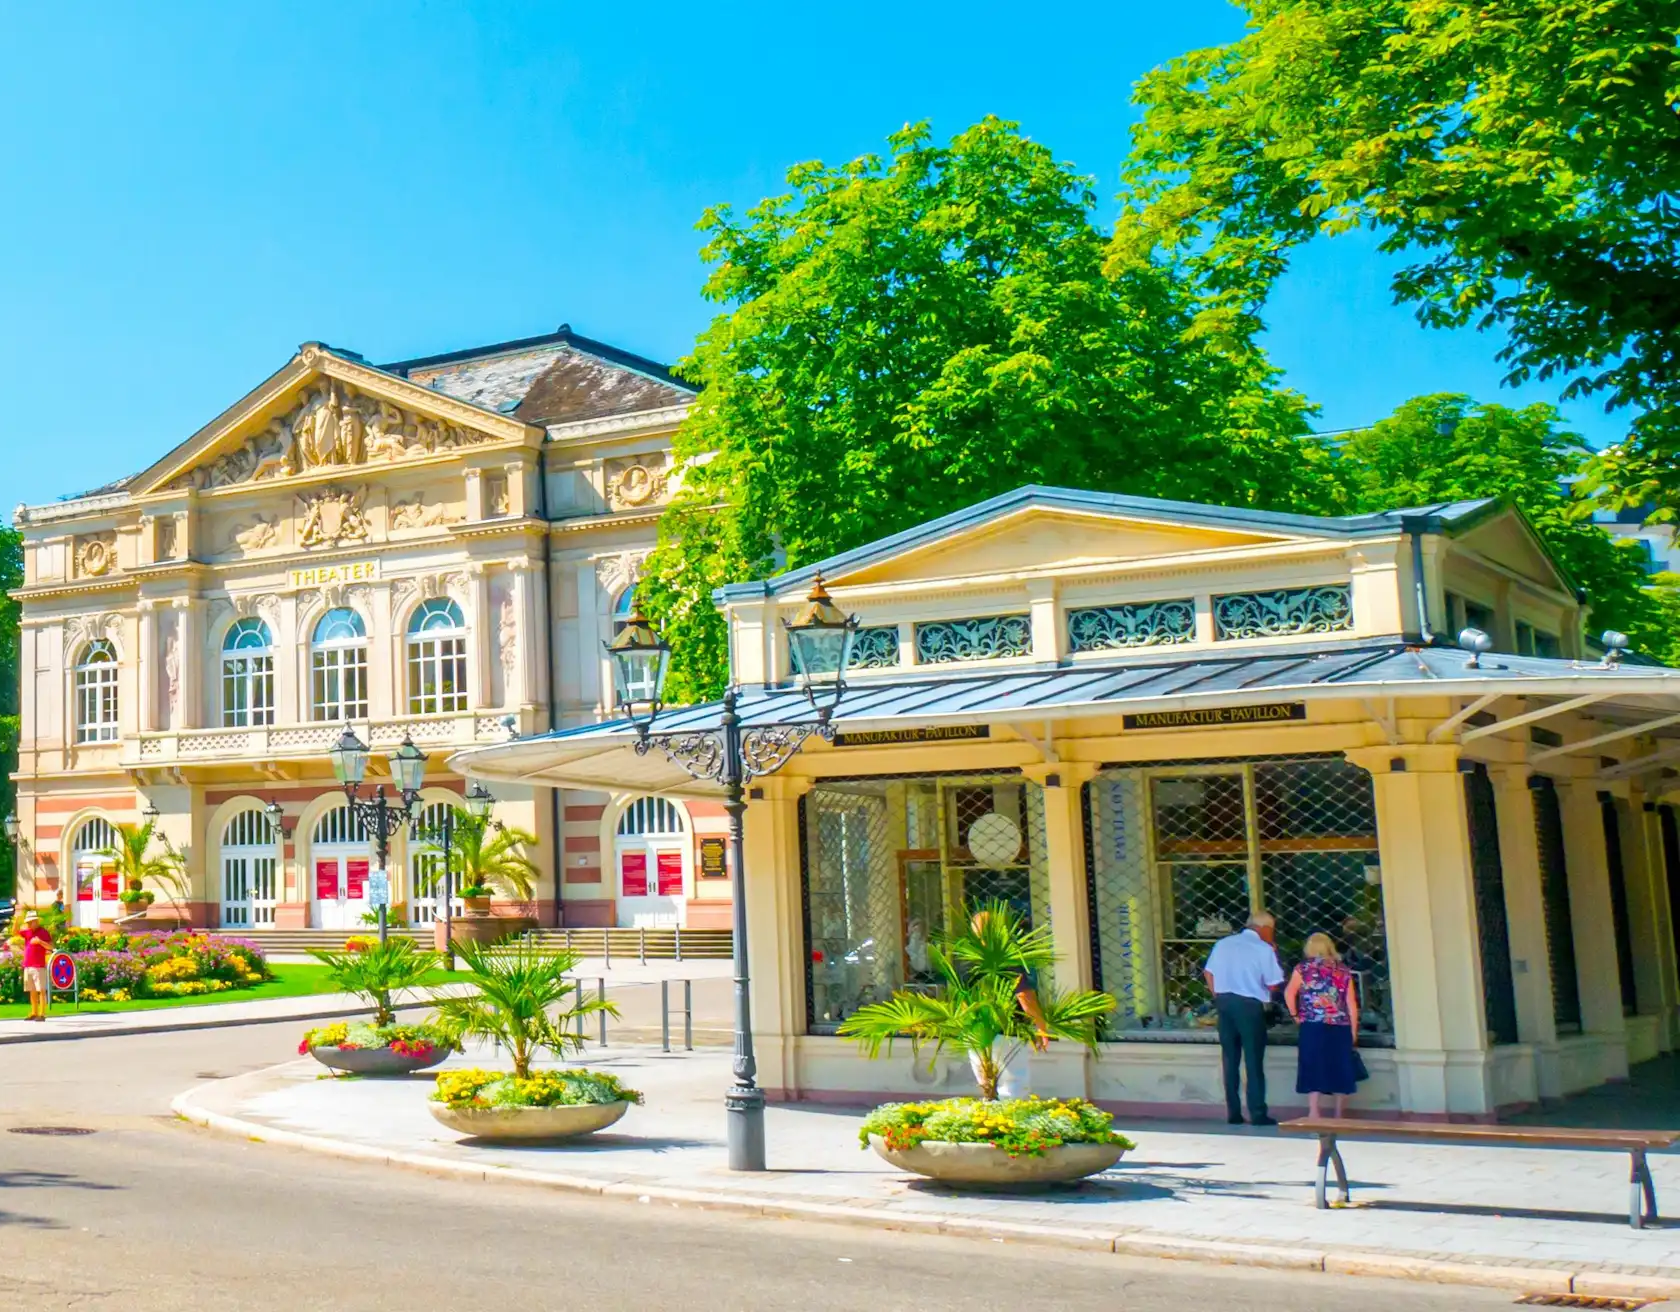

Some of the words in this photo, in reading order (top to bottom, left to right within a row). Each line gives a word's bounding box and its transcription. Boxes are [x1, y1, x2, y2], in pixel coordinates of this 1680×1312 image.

[292, 562, 375, 586] THEATER
[1136, 704, 1291, 727] MANUFAKTUR-PAVILLON
[843, 725, 978, 744] MANUFAKTUR-PAVILLON
